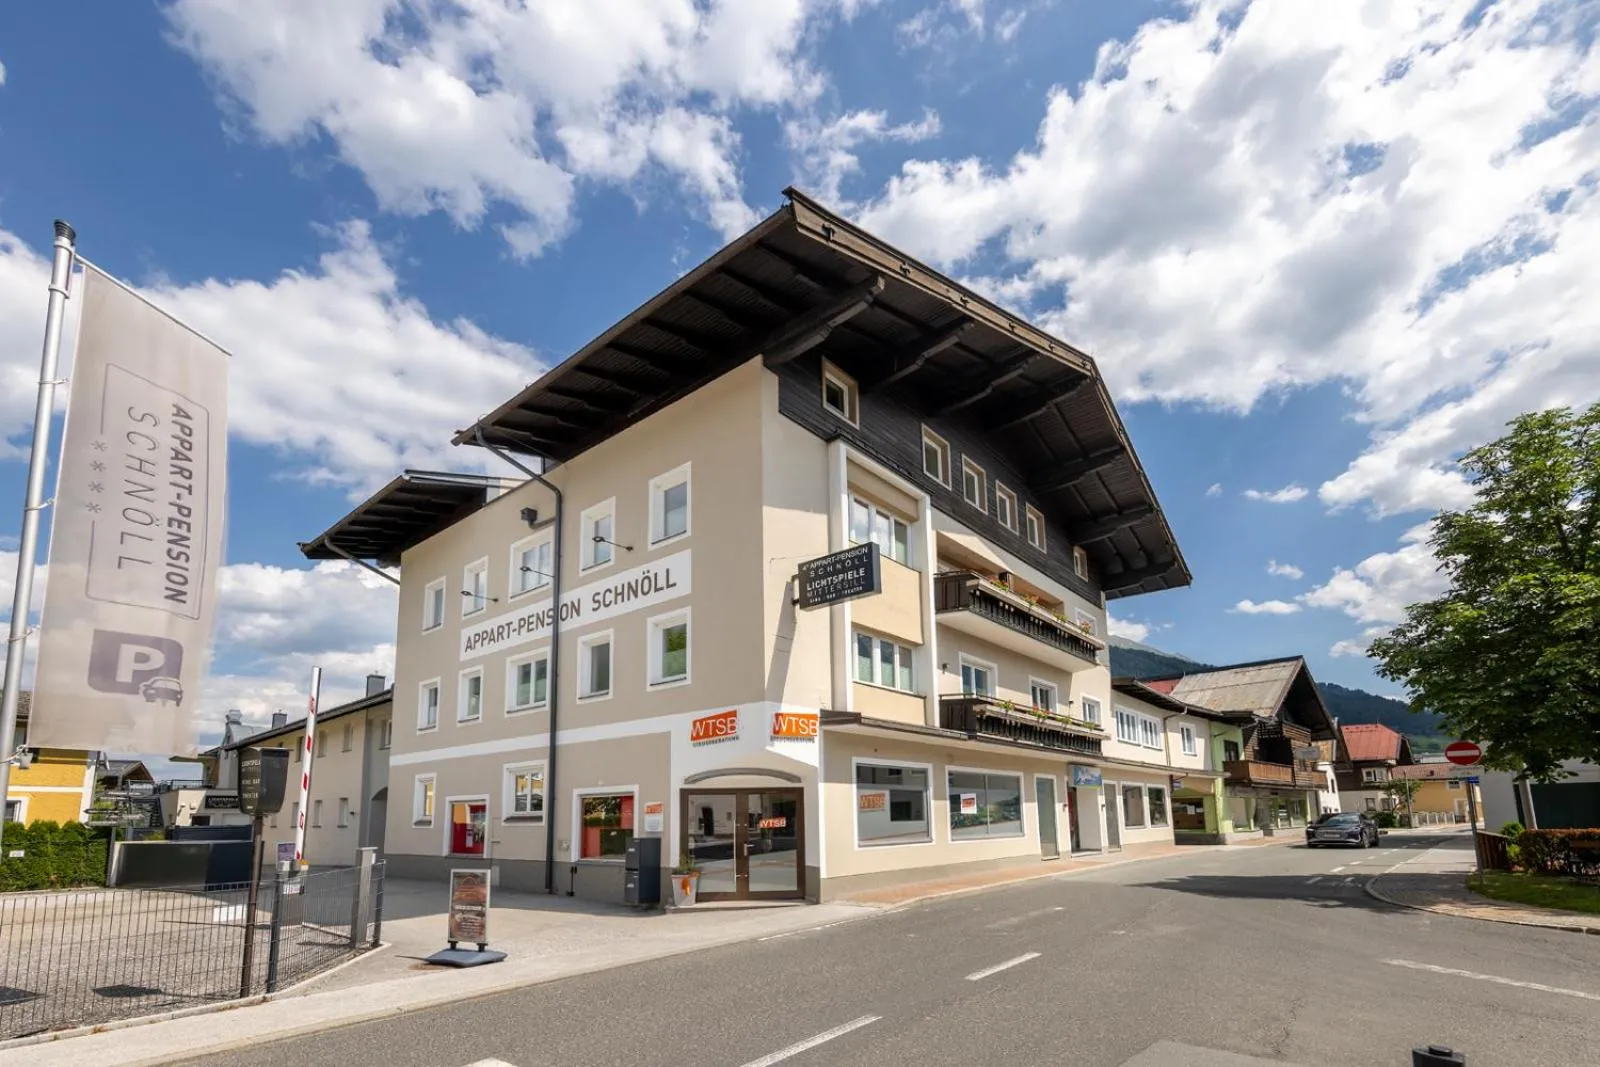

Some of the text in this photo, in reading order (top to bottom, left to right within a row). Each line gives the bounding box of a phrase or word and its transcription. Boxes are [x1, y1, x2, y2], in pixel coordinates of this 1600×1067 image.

[117, 406, 162, 571] SCHNÖLL
[163, 403, 194, 605] APPART-PENSION
[806, 567, 866, 591] LICHTSPIELE
[464, 568, 678, 653] APPART-PENSON SCHNÖLL
[691, 716, 737, 738] WTSB
[772, 714, 819, 736] WTSB
